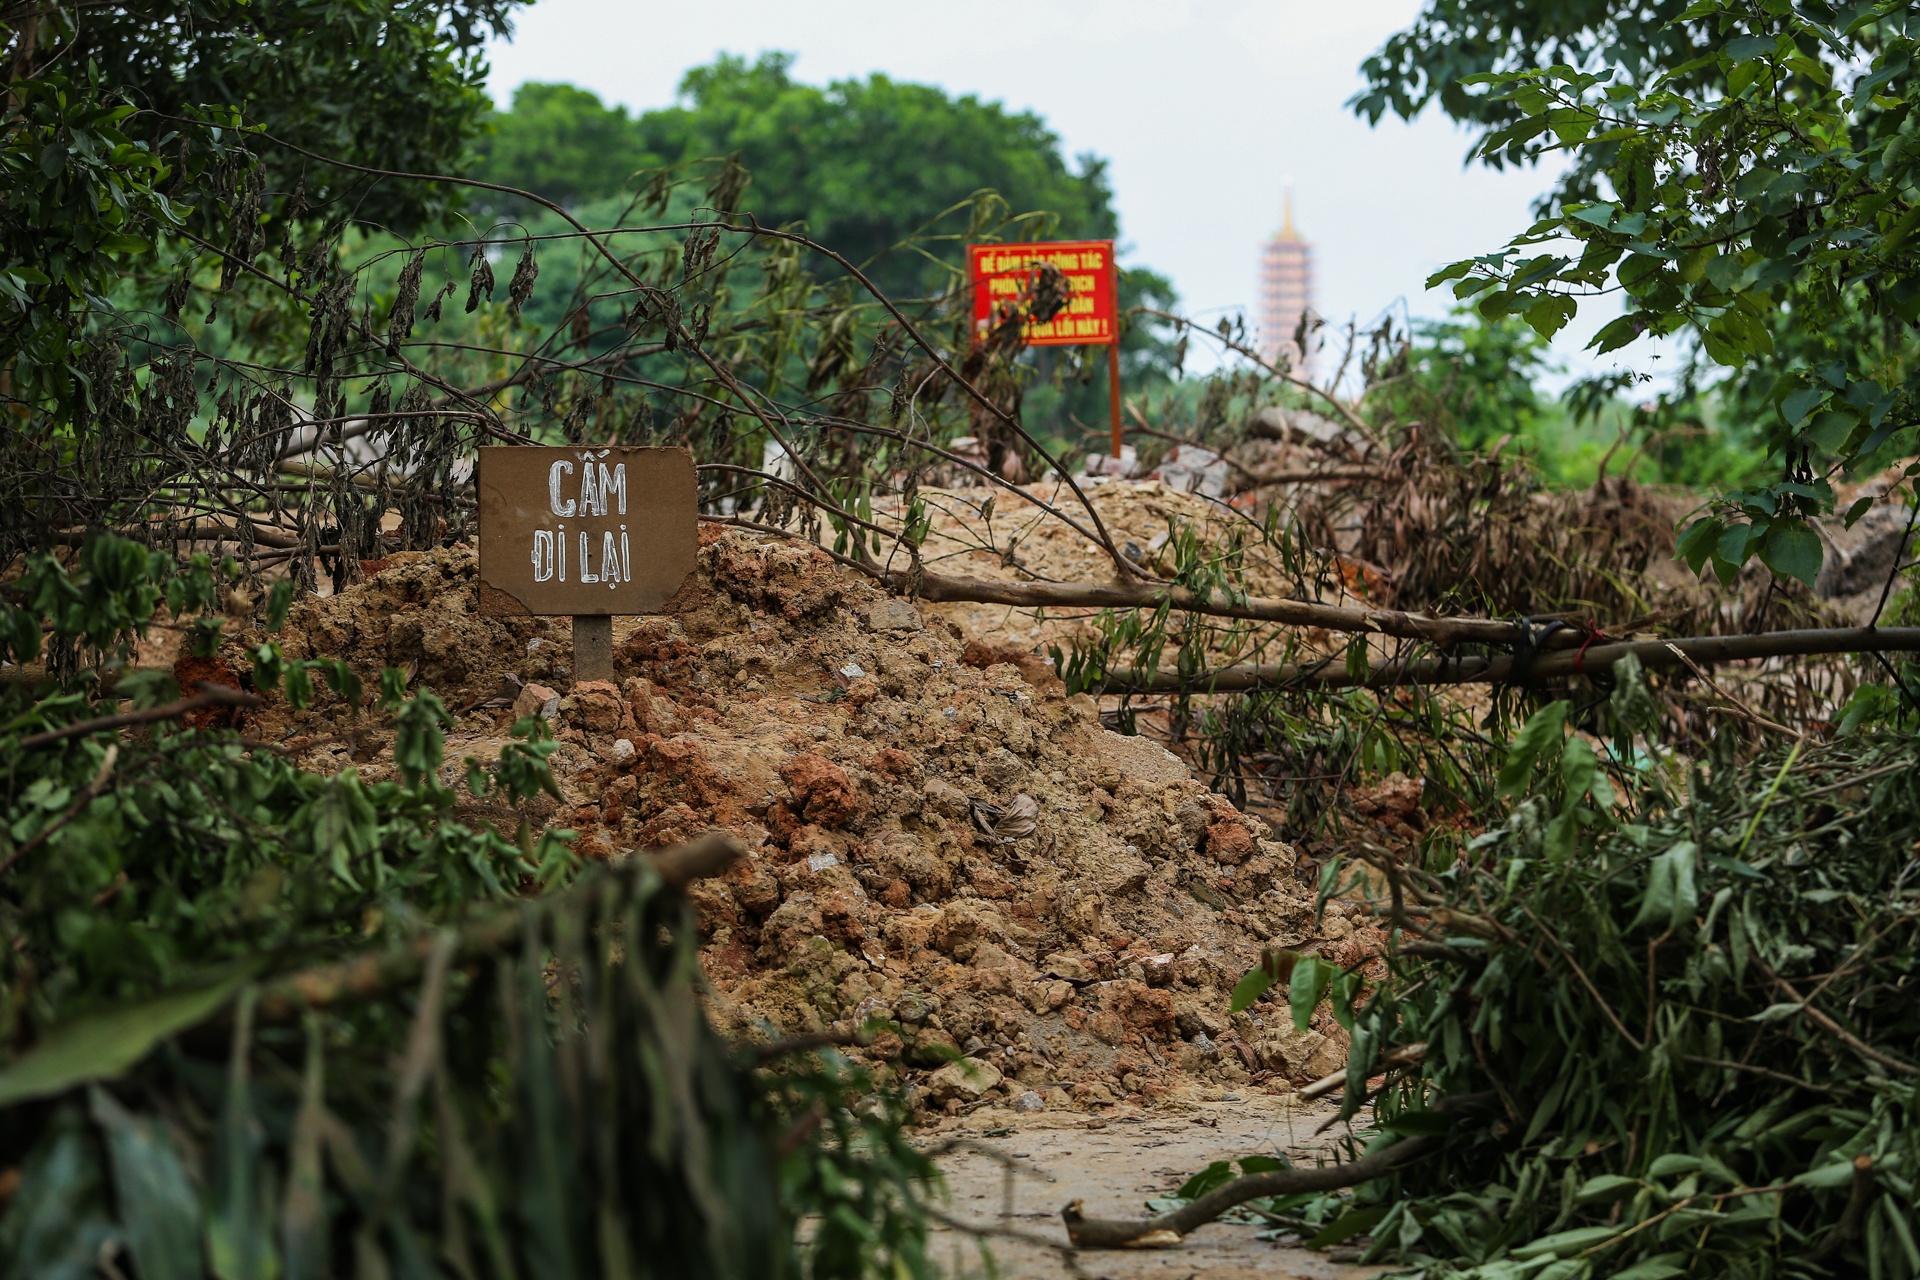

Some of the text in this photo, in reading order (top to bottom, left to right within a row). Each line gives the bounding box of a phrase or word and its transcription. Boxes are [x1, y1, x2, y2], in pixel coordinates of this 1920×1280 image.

[1080, 250, 1103, 270] TÁC
[548, 449, 627, 518] CẤM
[531, 524, 631, 589] ĐI LẠI
